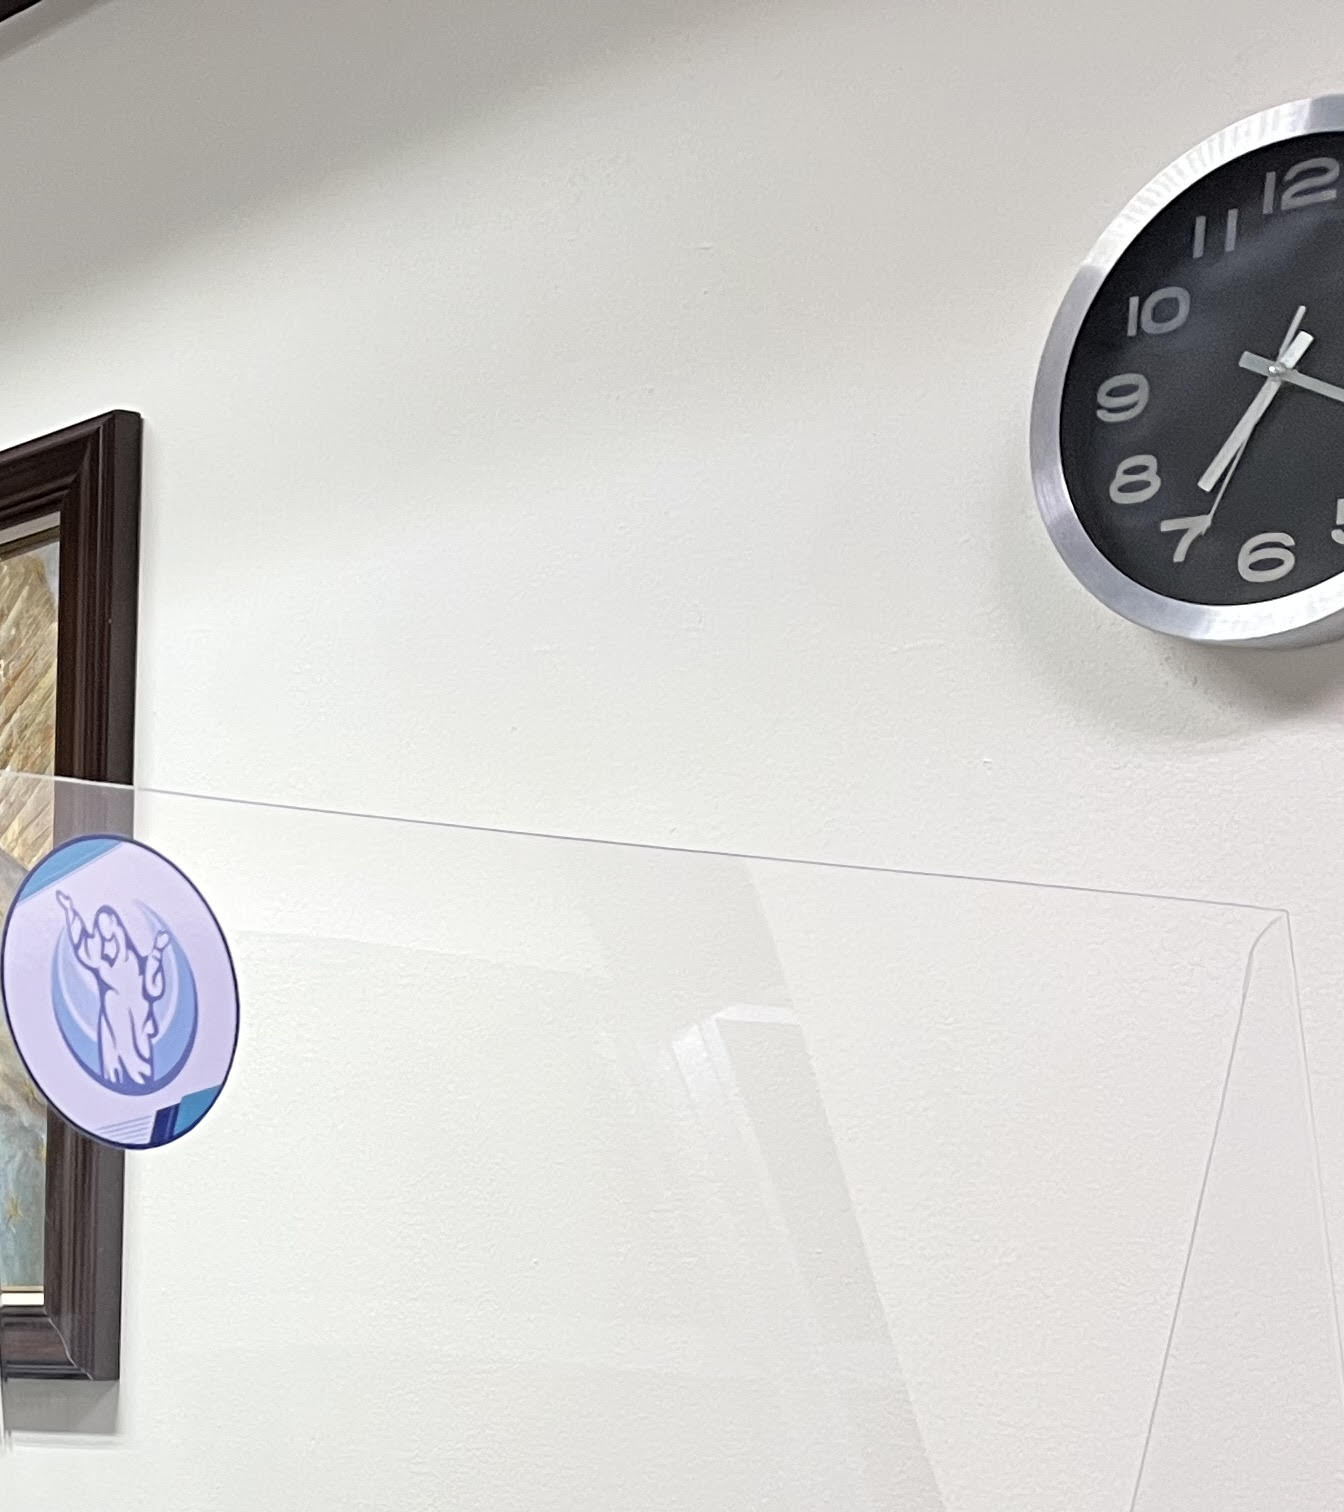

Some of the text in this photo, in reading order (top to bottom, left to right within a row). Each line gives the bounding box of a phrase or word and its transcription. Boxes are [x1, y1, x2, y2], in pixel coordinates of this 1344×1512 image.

[1262, 157, 1340, 215] 12
[1192, 208, 1238, 259] 11
[1126, 286, 1191, 337] 10
[1096, 373, 1150, 423] 9
[1109, 454, 1161, 504] 8
[1160, 514, 1211, 563] 7
[1237, 532, 1296, 583] 6
